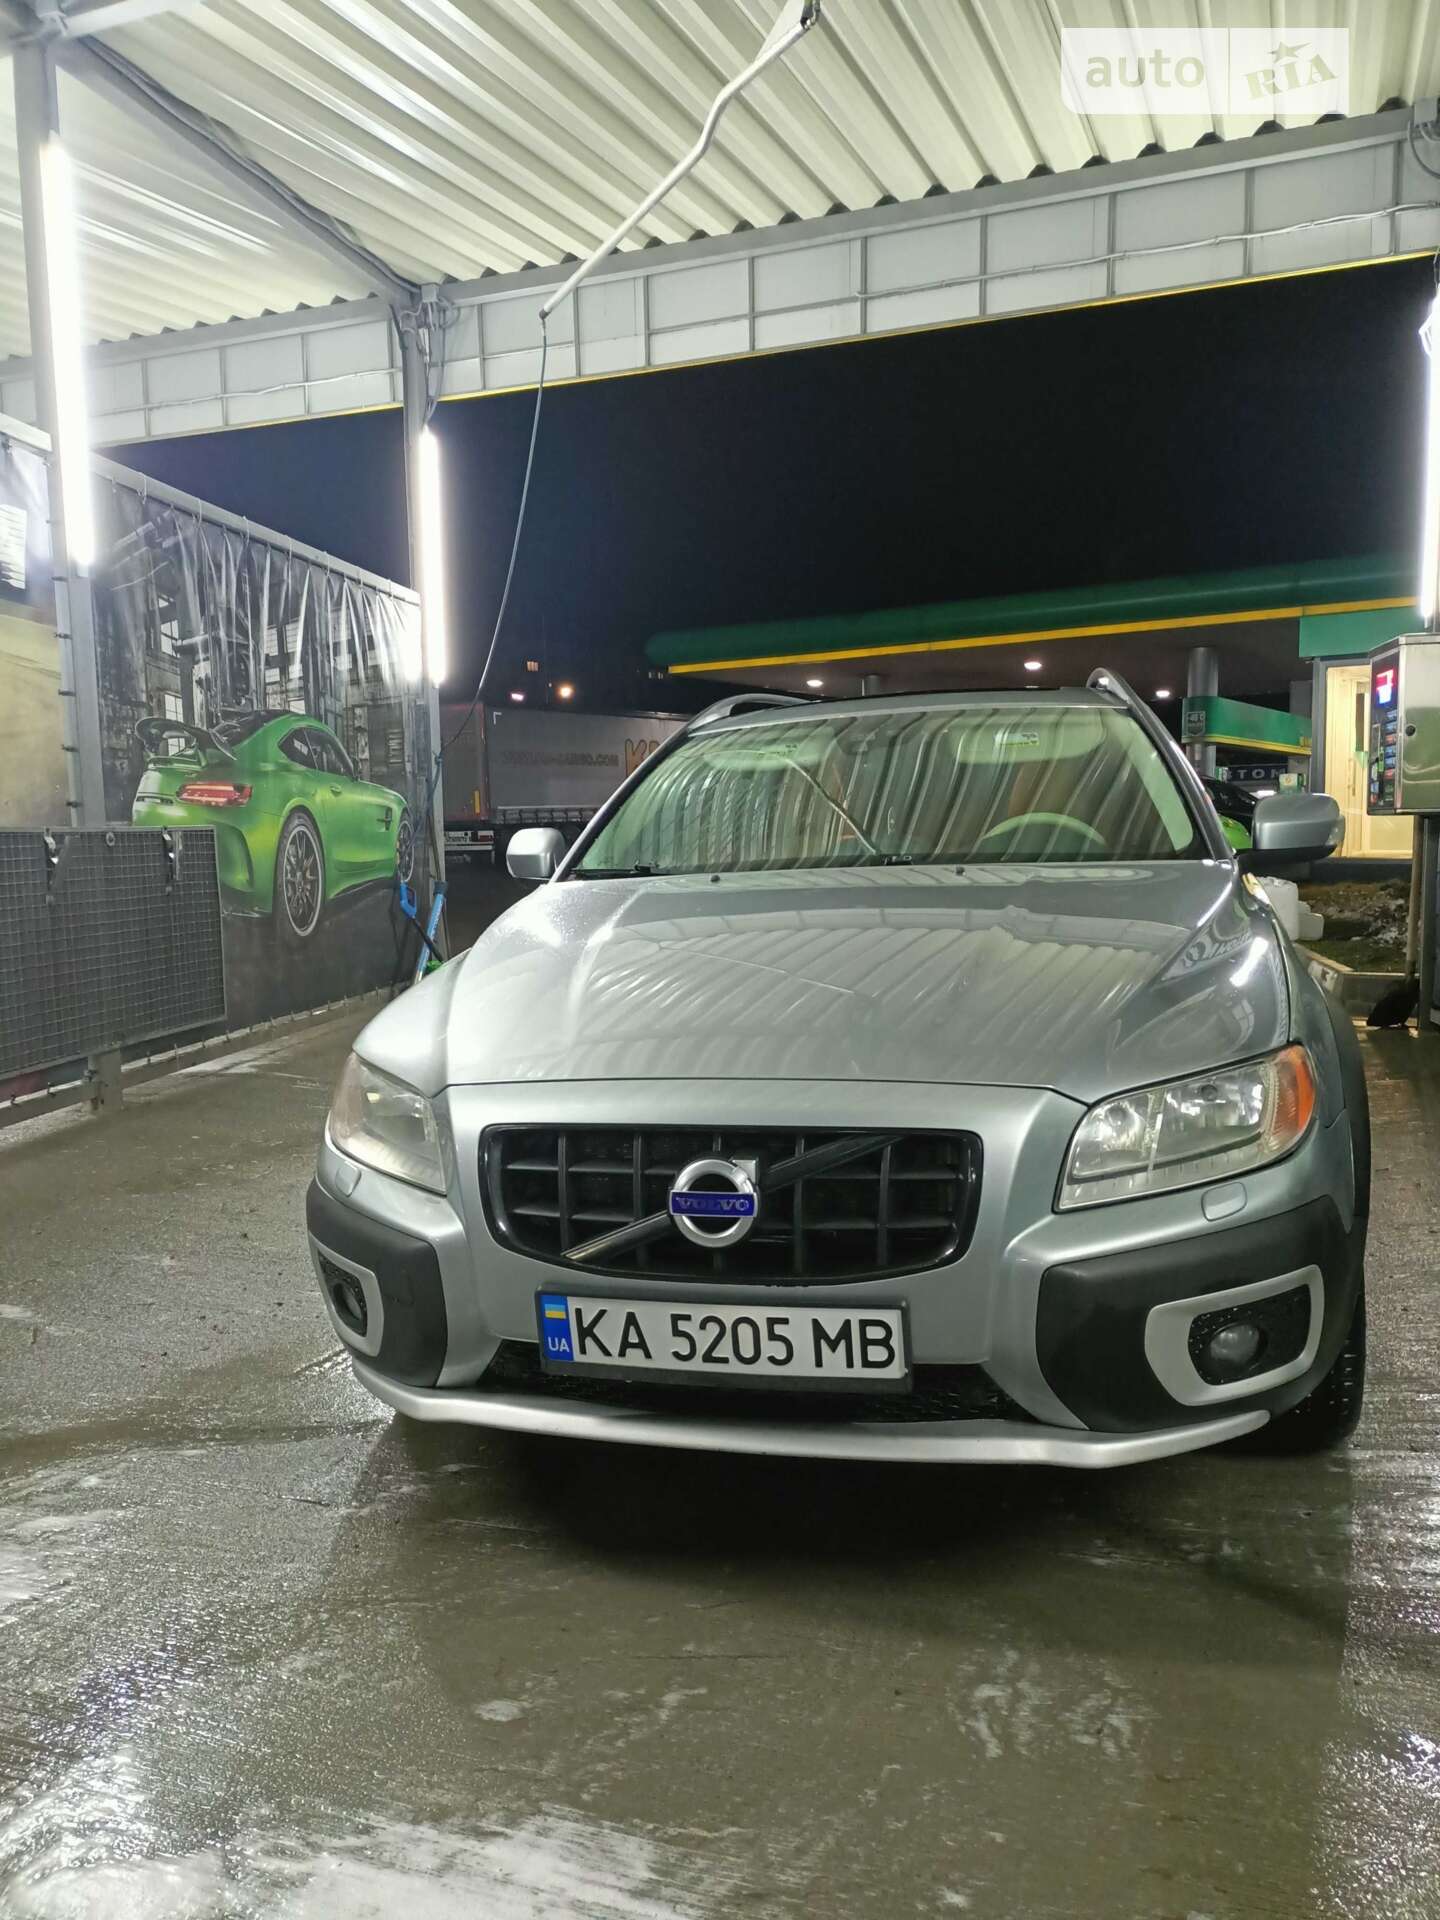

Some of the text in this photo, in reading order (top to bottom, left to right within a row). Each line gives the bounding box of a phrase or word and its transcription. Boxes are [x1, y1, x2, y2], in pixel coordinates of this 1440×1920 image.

[675, 1197, 749, 1211] VOLVO
[549, 1337, 570, 1352] UA
[575, 1308, 896, 1369] KA 5205 MB
